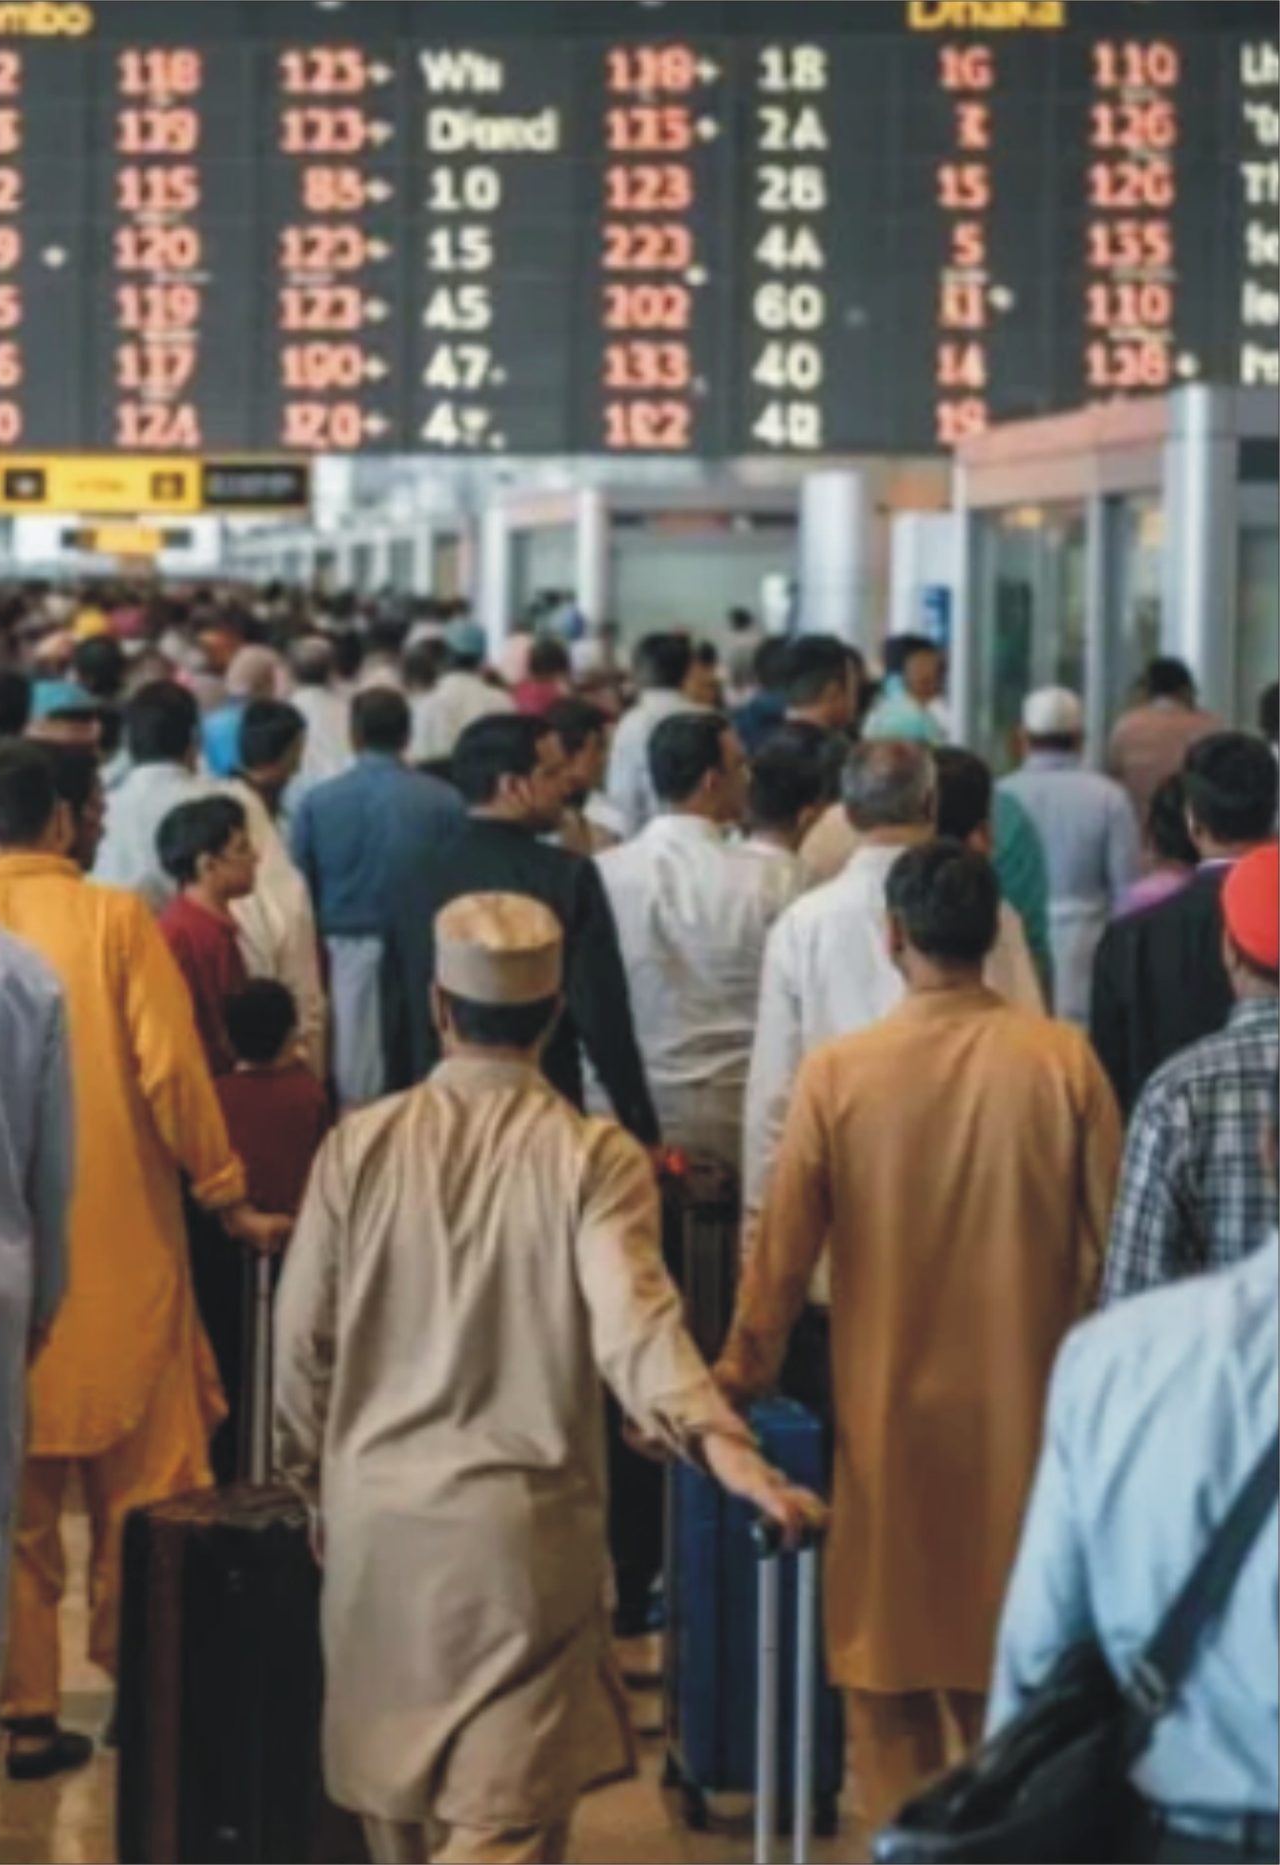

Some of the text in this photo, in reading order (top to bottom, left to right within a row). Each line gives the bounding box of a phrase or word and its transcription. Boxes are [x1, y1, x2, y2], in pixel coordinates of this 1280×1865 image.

[760, 107, 826, 150] 2A
[430, 167, 499, 210] 10
[430, 227, 492, 270] 15
[754, 284, 823, 329] 60
[753, 343, 821, 389] 40
